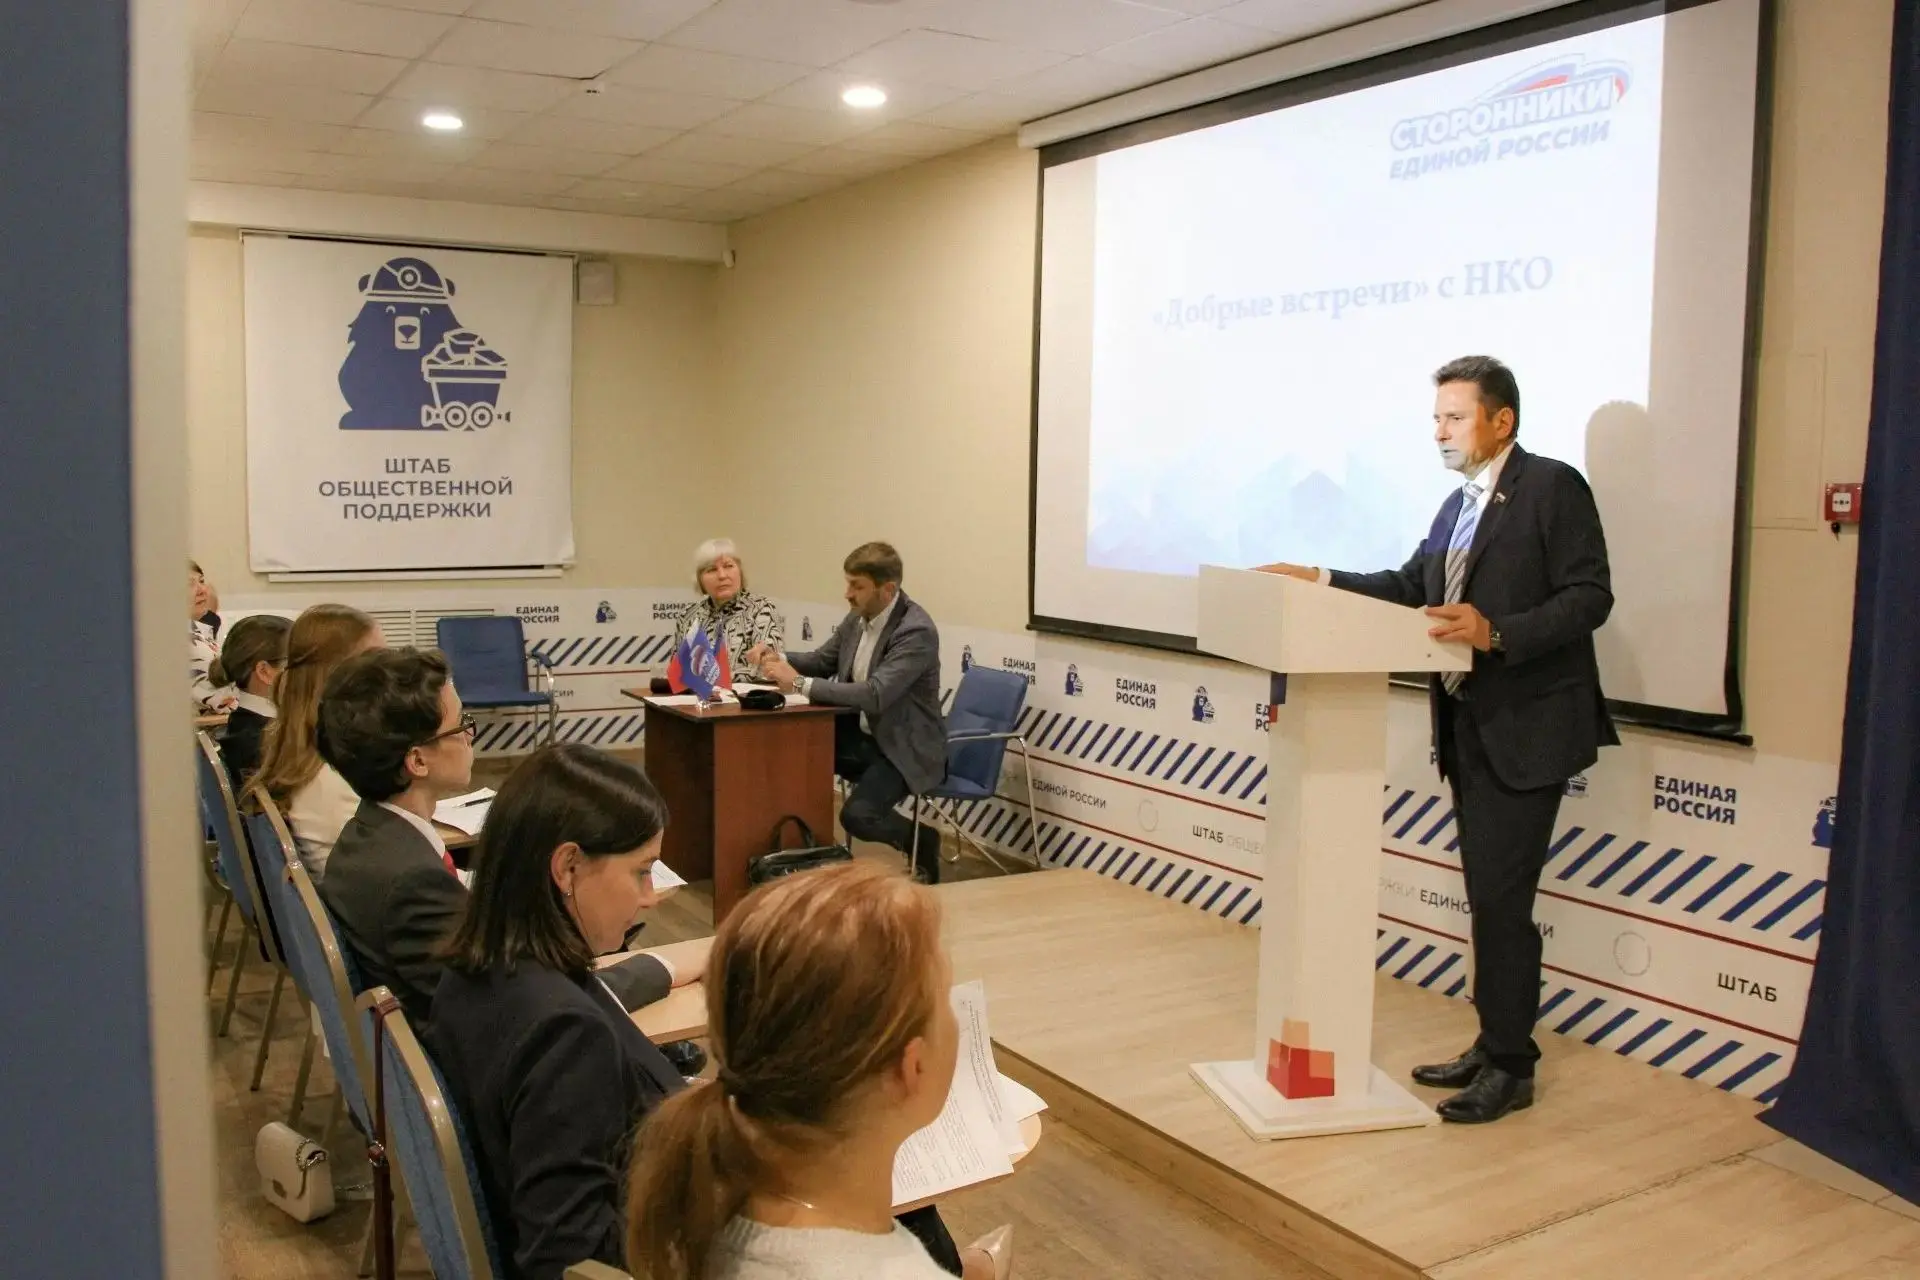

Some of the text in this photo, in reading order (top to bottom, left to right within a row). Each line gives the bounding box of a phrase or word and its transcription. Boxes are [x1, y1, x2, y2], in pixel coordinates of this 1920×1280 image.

[1390, 75, 1614, 151] СТОРОННИКИ
[1389, 120, 1611, 180] ЕДИНОЙ РОССИИ
[1152, 255, 1554, 331] «Добрые встречи» с НКО
[385, 458, 451, 474] ШТАБ
[319, 476, 513, 499] ОБЩЕСТВЕННОЙ
[343, 502, 491, 521] ПОДДЕРЖКИ
[516, 606, 560, 614] ЕДИНАЯ
[652, 603, 687, 611] ЕДИНА
[653, 612, 679, 620] РОСС
[1002, 657, 1036, 672] ЕДИНАЯ
[1116, 678, 1156, 695] ЕДИНАЯ
[1116, 692, 1156, 709] РОССИЯ
[1032, 779, 1106, 808] ЕДИНОЙ РОССИИ
[1654, 775, 1737, 804] ЕДИНАЯ
[1653, 794, 1736, 825] РОССИЯ
[1192, 825, 1224, 843] ШТАБ
[1420, 889, 1473, 915] ЕДИНО
[1718, 973, 1778, 1003] ШТАБ
